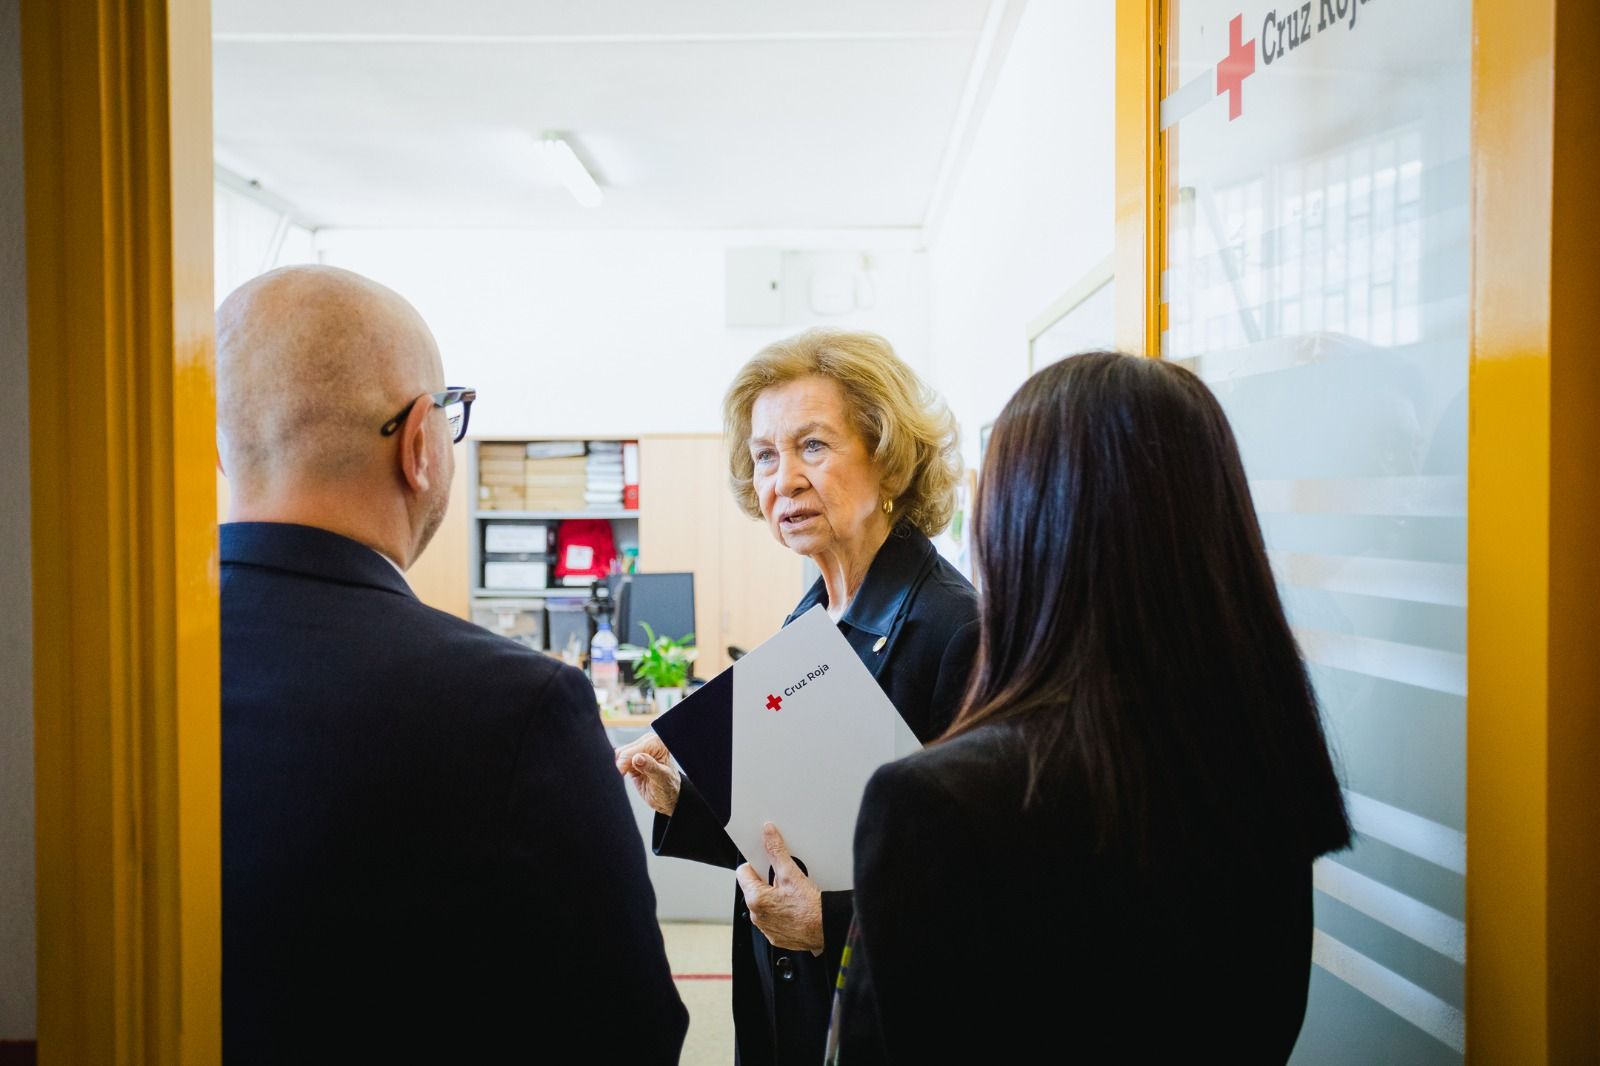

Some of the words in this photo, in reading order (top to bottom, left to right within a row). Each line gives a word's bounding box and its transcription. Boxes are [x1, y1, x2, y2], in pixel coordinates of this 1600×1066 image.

[1262, 1, 1311, 65] Cruz
[1317, 0, 1372, 32] Roj
[784, 679, 807, 697] Cruz
[806, 663, 830, 681] Roja
